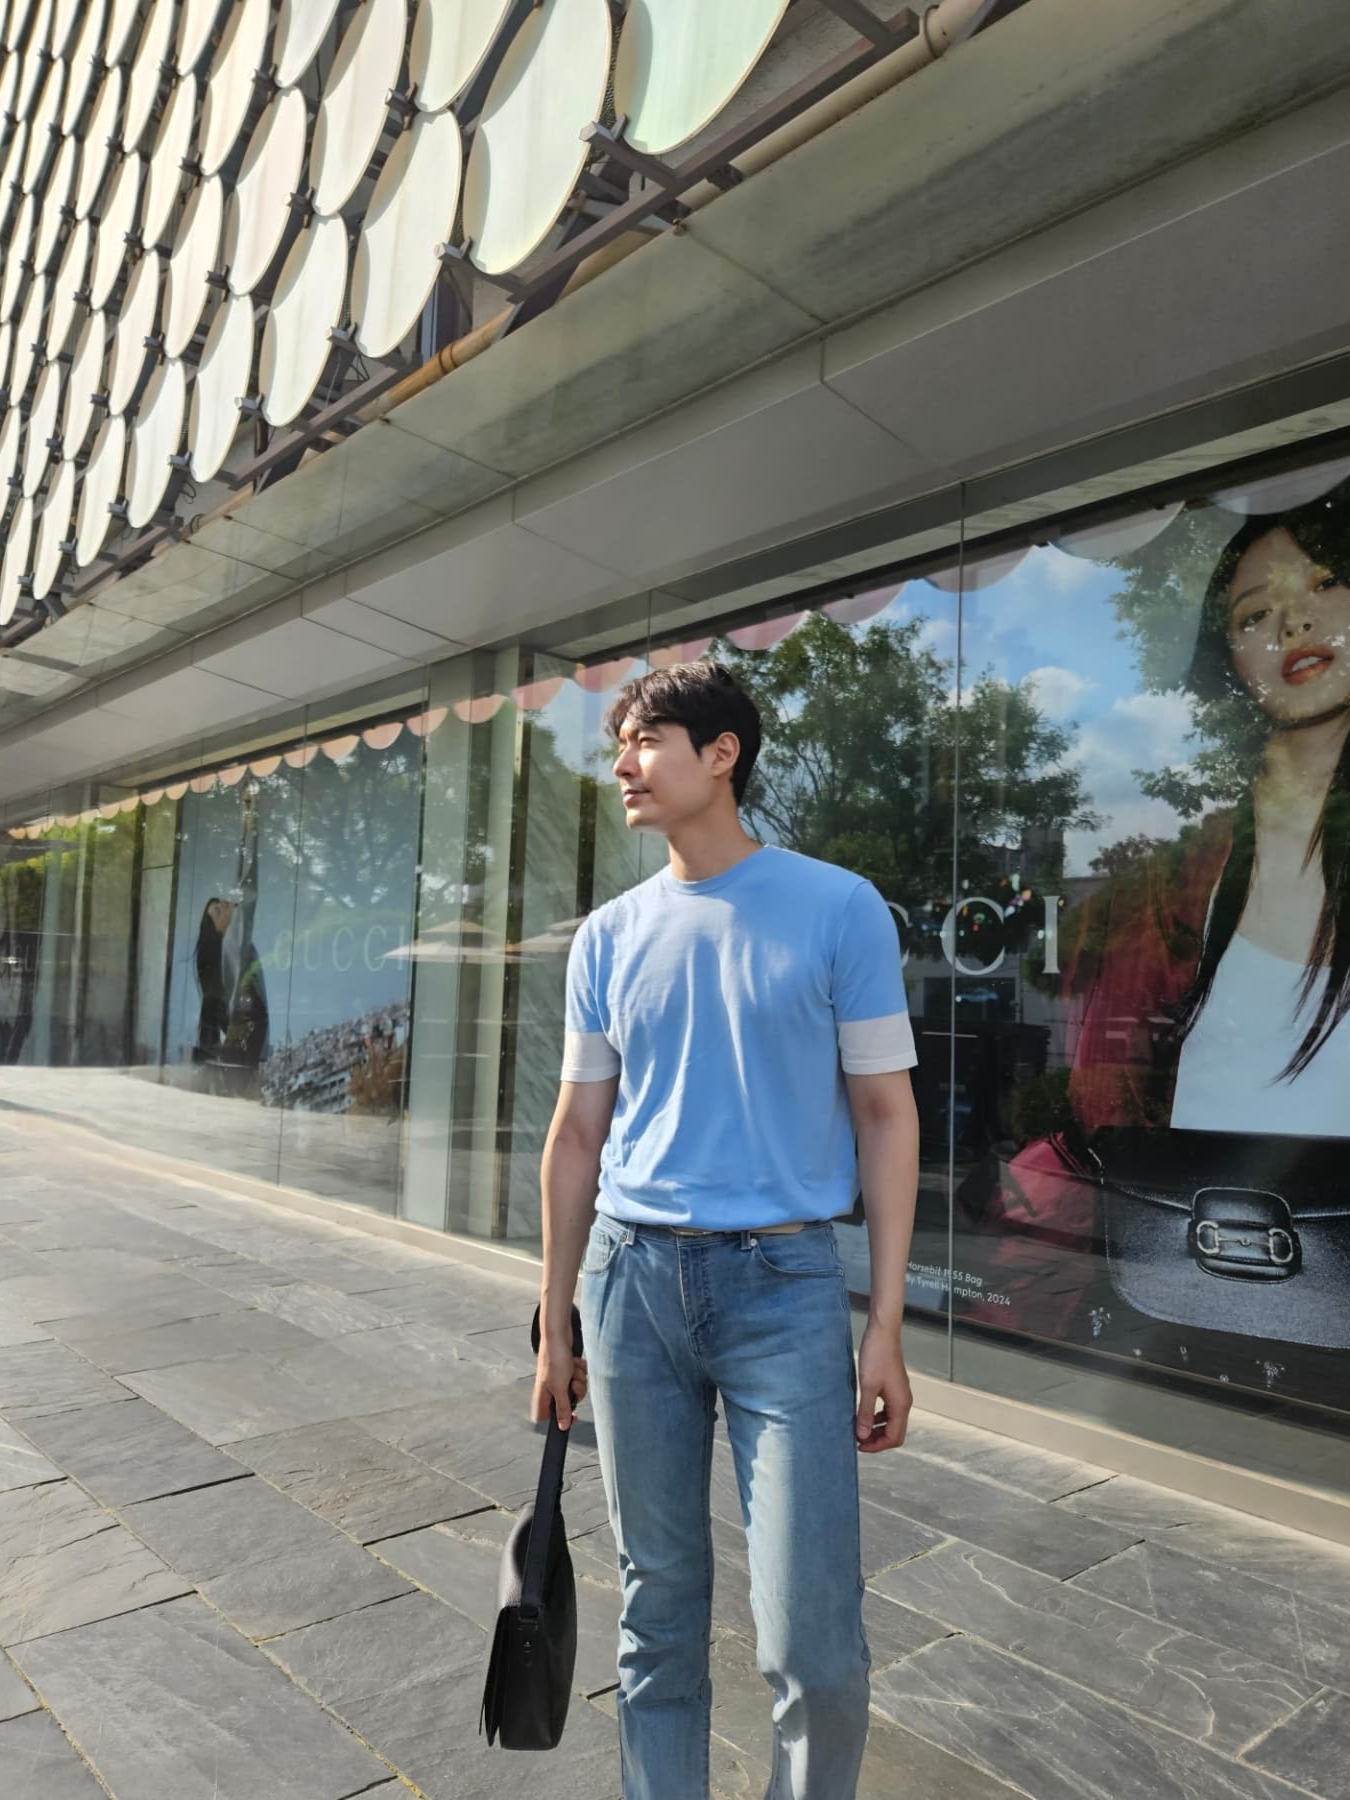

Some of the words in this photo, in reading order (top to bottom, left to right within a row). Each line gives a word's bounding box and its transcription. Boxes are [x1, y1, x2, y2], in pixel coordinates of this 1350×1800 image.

[274, 925, 406, 972] GUCCI
[965, 1273, 983, 1287] Bag
[987, 1292, 1011, 1307] 2024
